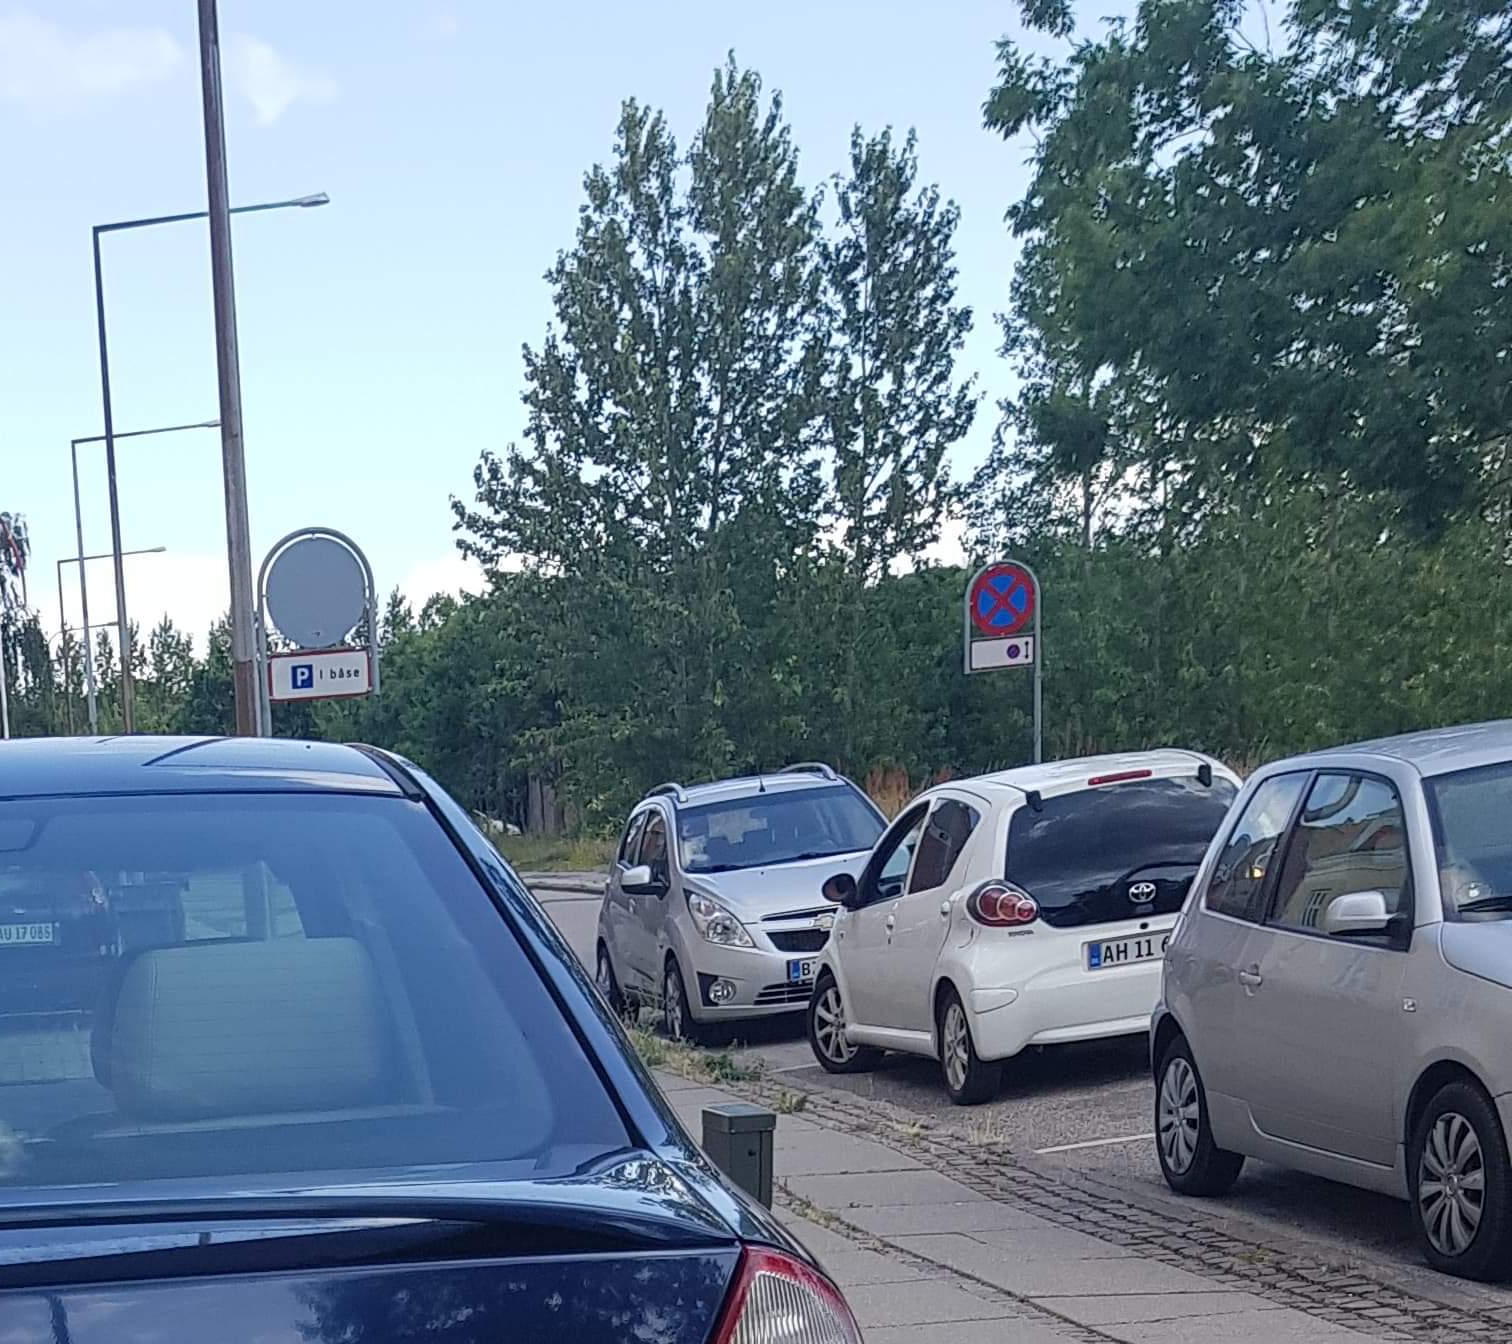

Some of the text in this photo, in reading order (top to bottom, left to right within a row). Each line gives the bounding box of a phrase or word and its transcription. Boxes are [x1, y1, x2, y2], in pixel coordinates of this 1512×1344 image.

[296, 667, 309, 687] P
[329, 667, 360, 680] båse
[16, 926, 27, 940] 17
[1103, 942, 1128, 963] AH
[1135, 938, 1155, 958] 11
